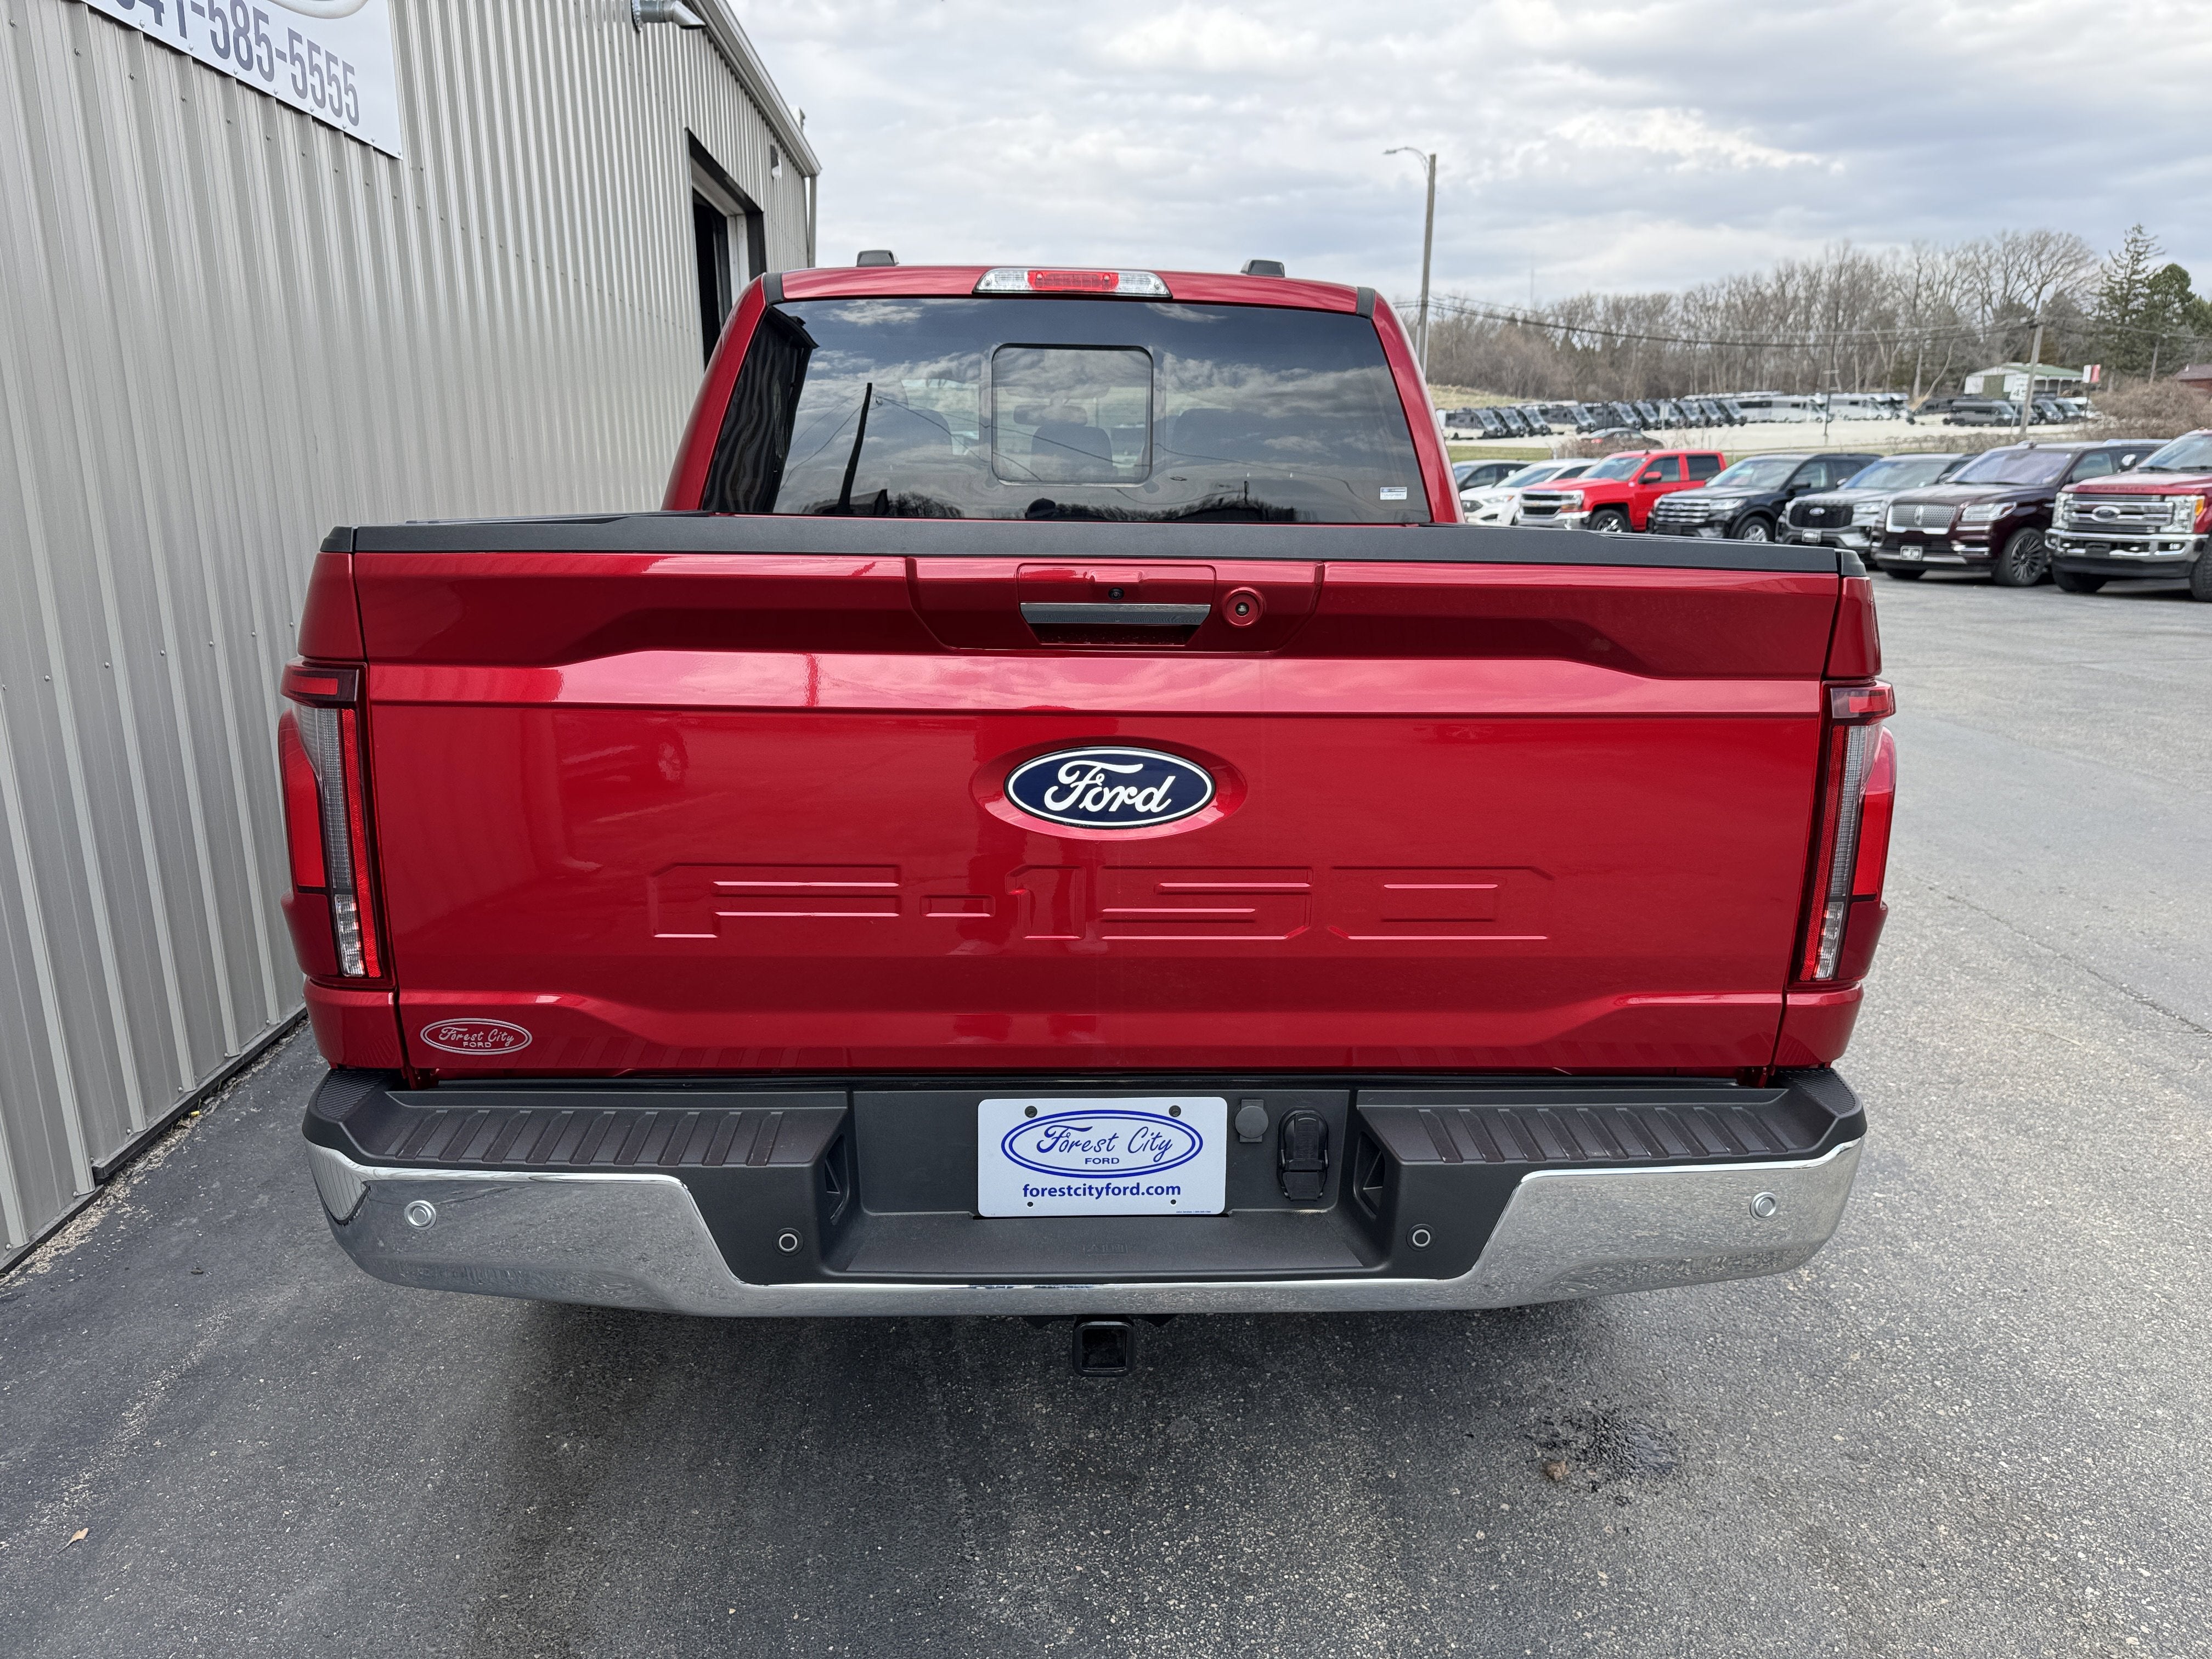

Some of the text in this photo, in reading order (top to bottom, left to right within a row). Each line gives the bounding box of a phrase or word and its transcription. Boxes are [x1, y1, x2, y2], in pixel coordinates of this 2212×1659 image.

[116, 0, 359, 127] -585-5555
[1044, 760, 1176, 812] Ford
[648, 862, 1555, 940] F-150
[439, 1026, 515, 1047] Forest City
[1036, 1125, 1173, 1163] Forest City
[1023, 1183, 1181, 1200] forestcityford.com
